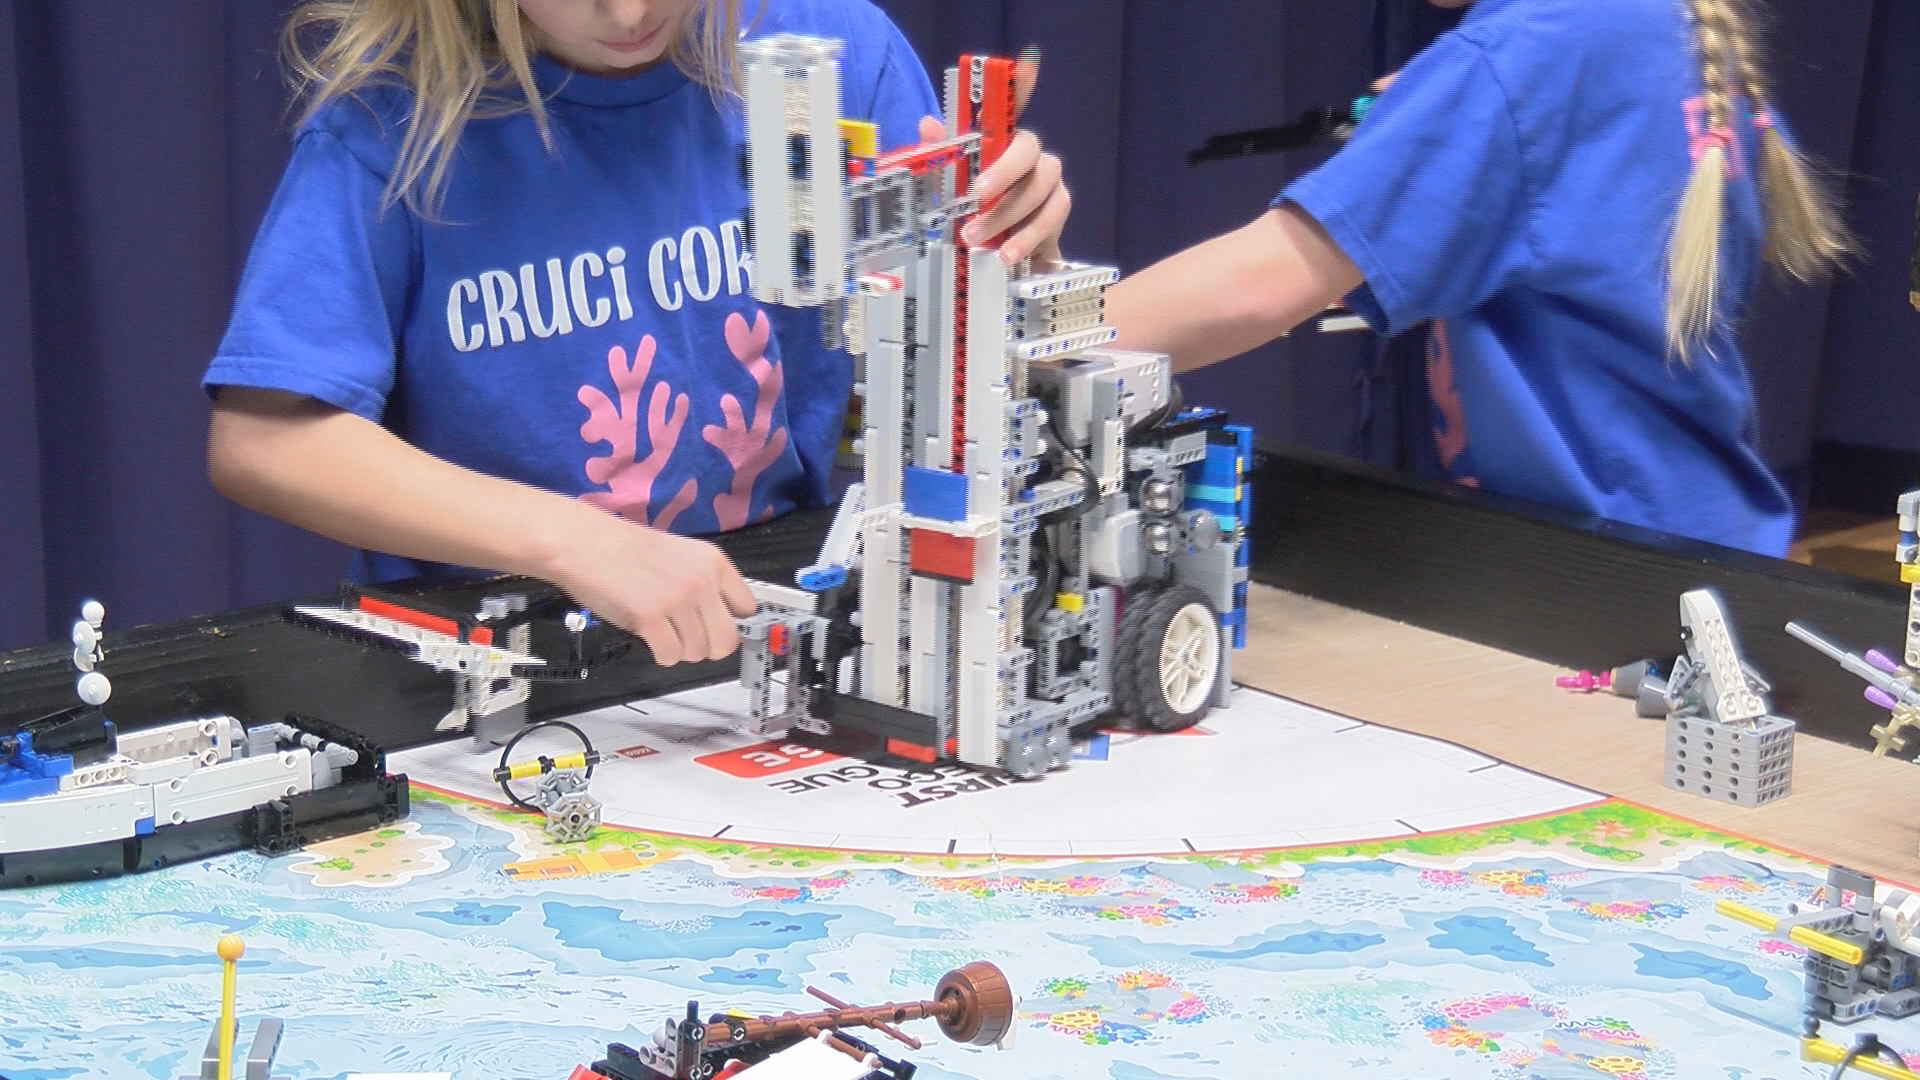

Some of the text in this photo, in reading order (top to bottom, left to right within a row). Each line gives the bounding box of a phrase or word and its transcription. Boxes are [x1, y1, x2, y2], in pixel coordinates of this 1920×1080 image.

[648, 220, 754, 312] COR
[766, 765, 880, 794] GUE
[896, 774, 1010, 808] IRST
